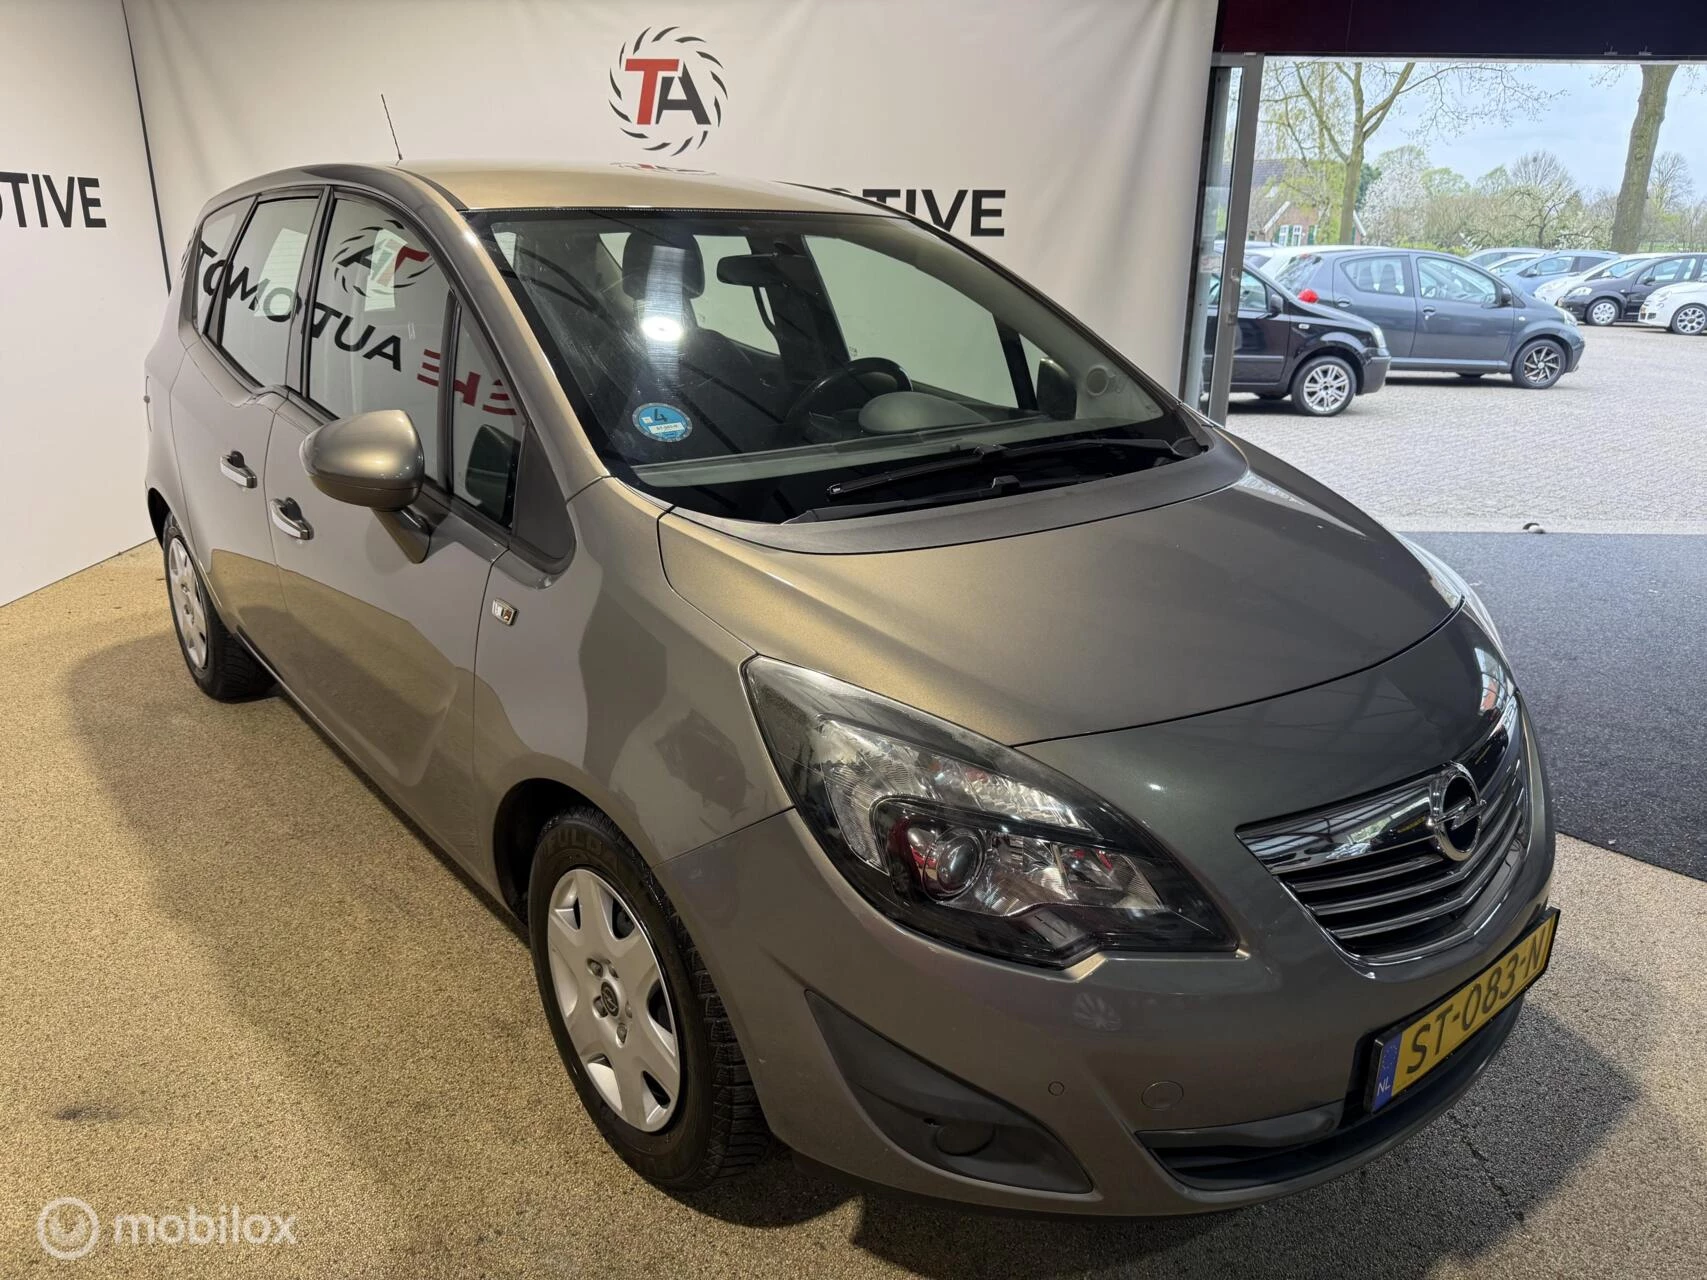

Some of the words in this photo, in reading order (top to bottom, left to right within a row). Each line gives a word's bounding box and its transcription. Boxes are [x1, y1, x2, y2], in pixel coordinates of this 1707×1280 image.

[625, 58, 711, 125] TA
[0, 172, 107, 228] TIVE
[831, 187, 1006, 237] TIVE
[654, 408, 668, 422] 4
[1406, 926, 1548, 1074] ST-083-N
[1376, 1077, 1391, 1097] NL
